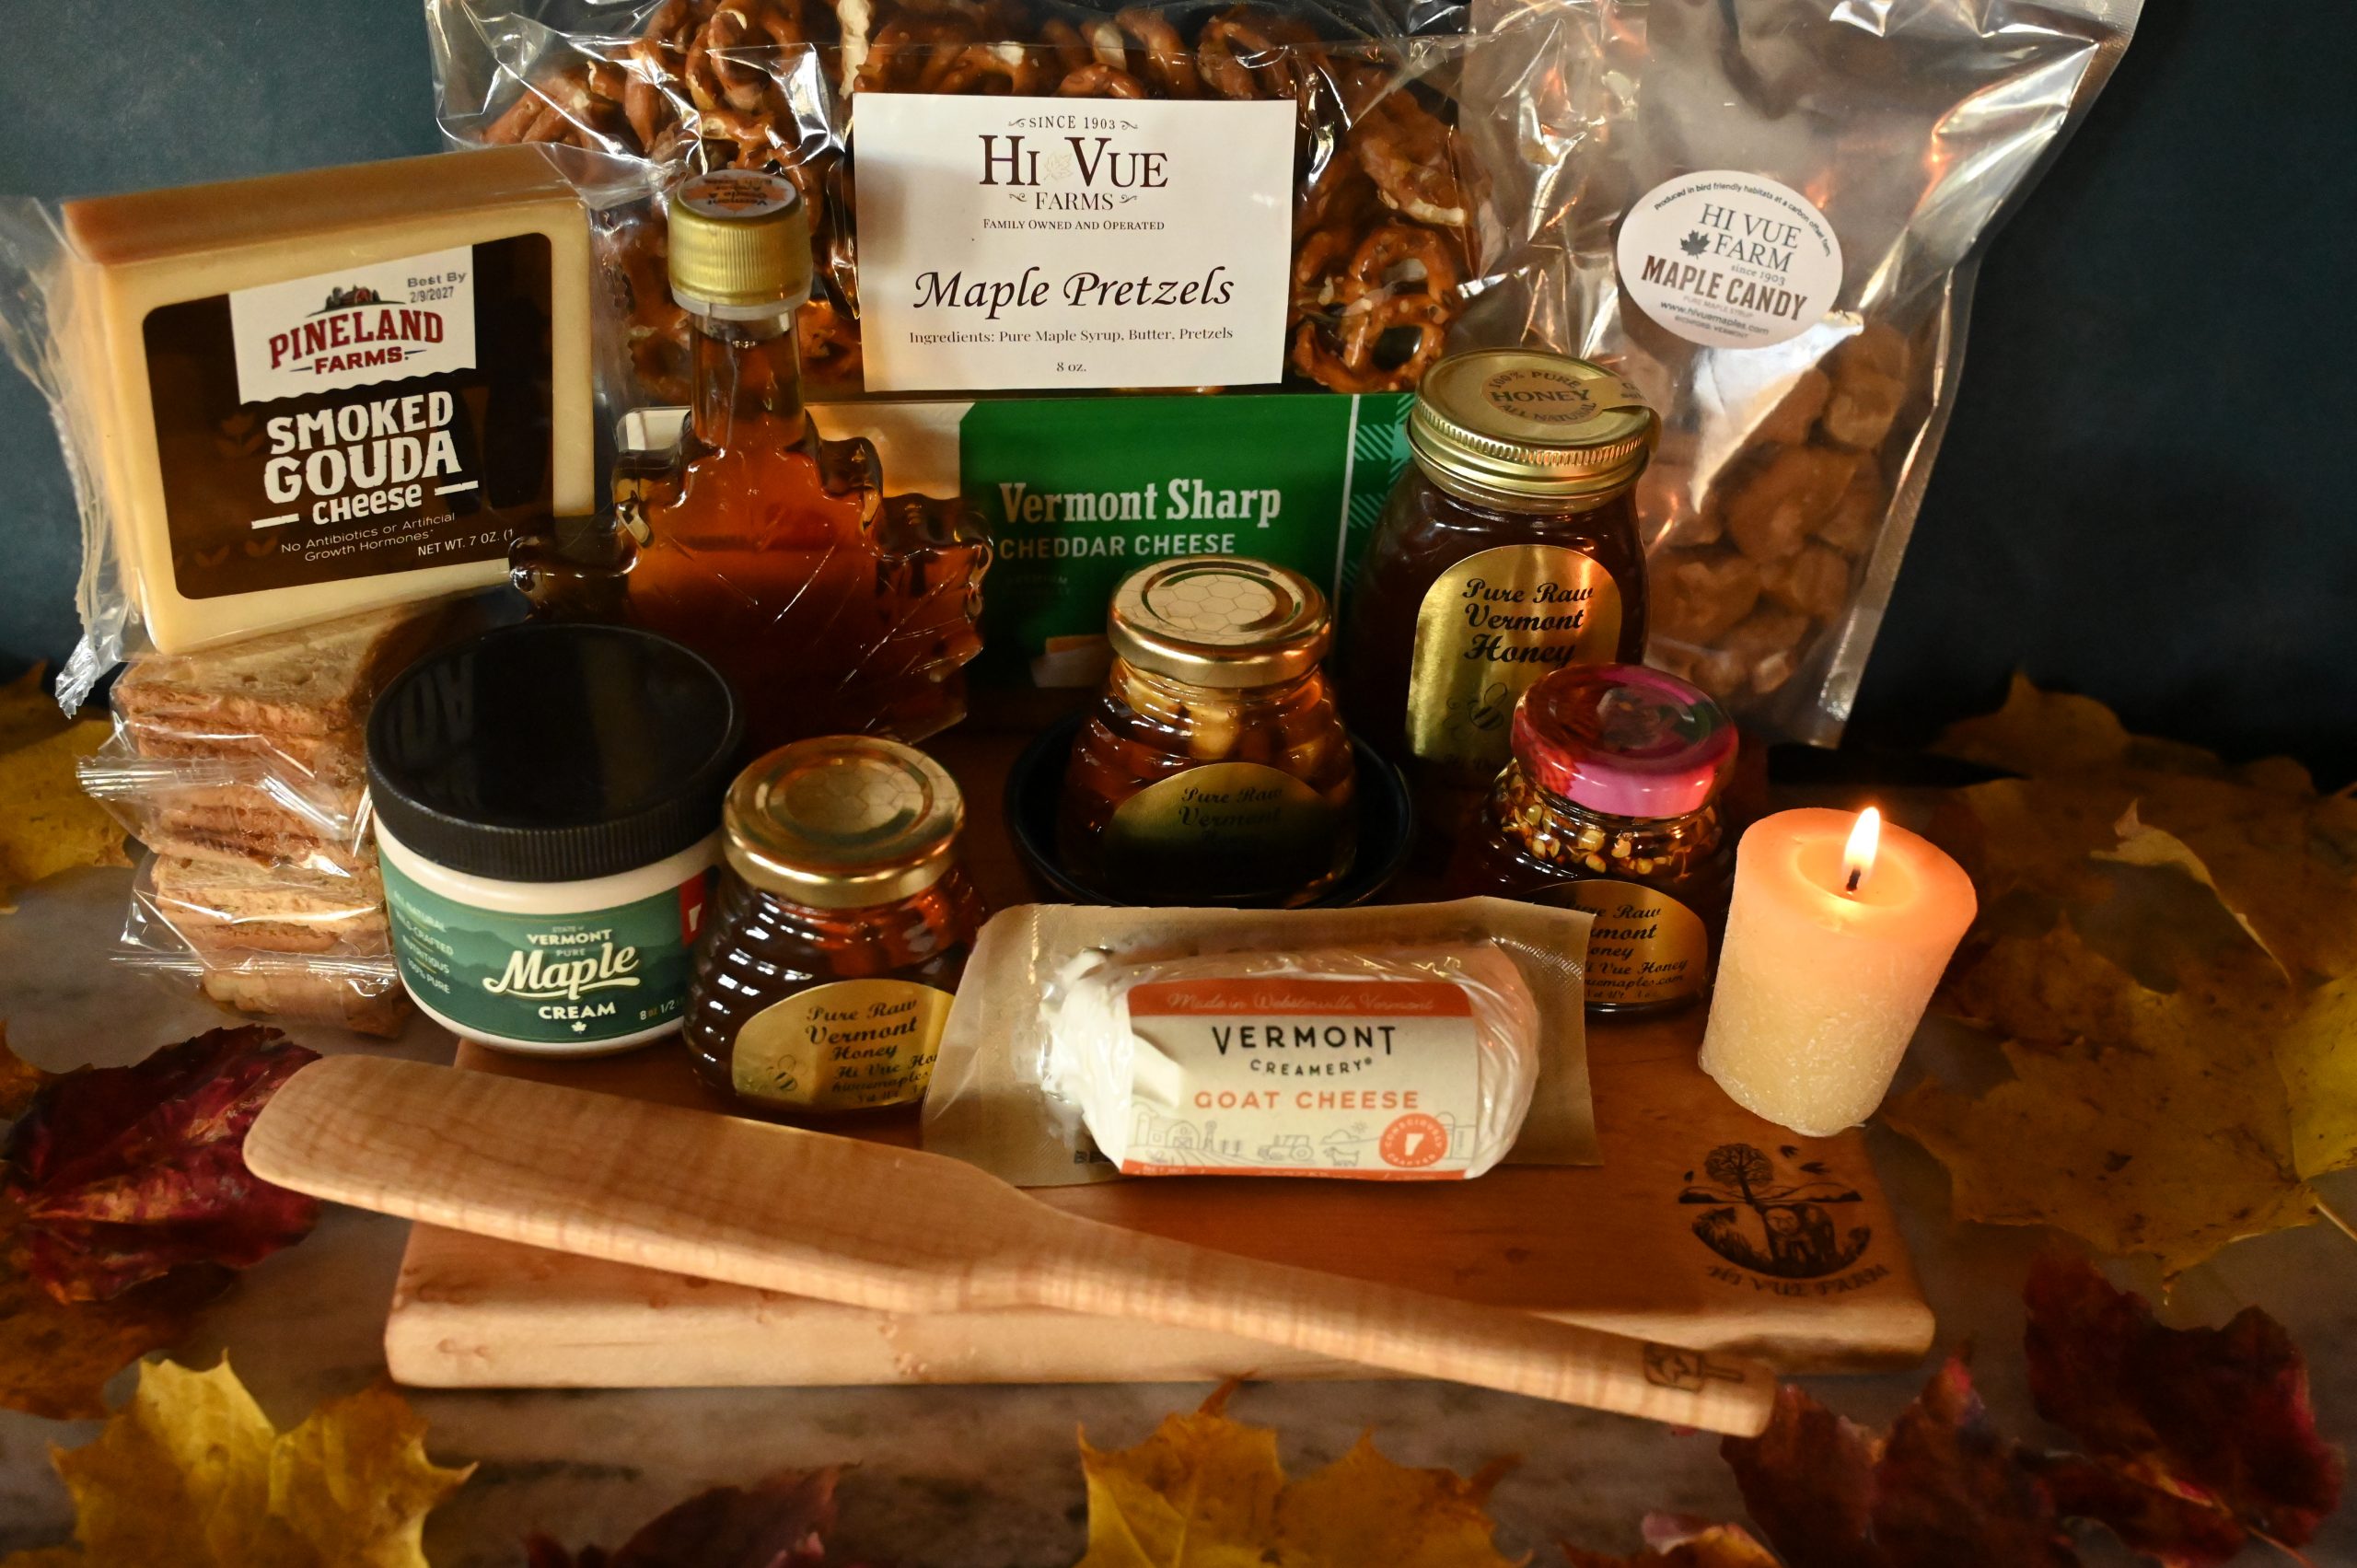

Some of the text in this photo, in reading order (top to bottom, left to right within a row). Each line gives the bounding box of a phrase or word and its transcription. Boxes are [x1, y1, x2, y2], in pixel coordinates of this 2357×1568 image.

[1029, 116, 1117, 131] SINCE 1903
[1036, 192, 1114, 211] FARMS
[1654, 188, 1687, 211] Produced
[1696, 183, 1712, 192] bird
[1713, 182, 1742, 192] friendly
[1744, 185, 1773, 199] habitats
[1774, 195, 1782, 203] at
[1788, 203, 1810, 223] carbon
[1698, 203, 1802, 249] HI VUE
[1713, 233, 1794, 273] FARM
[408, 272, 467, 288] Best By
[1731, 264, 1786, 286] since 1903
[411, 286, 455, 303] 2/9/2027
[913, 266, 1235, 319] Maple Pretzels
[1641, 254, 1808, 321] MAPLE CANDY
[268, 308, 444, 369] PINELAND
[910, 327, 1234, 344] Ingredients: Pure Maple Syrup, Butter, Pretzels
[1056, 362, 1087, 372] 8 oz.
[1489, 371, 1582, 389] 100% PURE
[1490, 389, 1591, 403] HONEY
[1500, 401, 1597, 423] ALL NATURAL
[266, 391, 454, 456] SMOKED
[263, 430, 462, 505] GOUDA
[999, 478, 1282, 528] Vermont Sharp
[282, 513, 456, 553] No Antibiotics or Artificial
[418, 544, 441, 556] NET
[445, 538, 466, 552] WT.
[470, 536, 477, 546] 7
[481, 531, 500, 544] OZ.
[305, 544, 355, 562] Growth
[999, 533, 1236, 560] CHEDDAR CHEESE
[1462, 577, 1594, 604] Pure Raw
[1464, 603, 1585, 632] Vermont
[1463, 633, 1576, 668] Honey
[1180, 787, 1230, 804] Pure
[1612, 904, 1662, 919] Raw
[527, 928, 613, 946] VERMONT
[1589, 923, 1658, 940] mont
[555, 947, 586, 958] PURE
[1589, 946, 1634, 961] oney
[482, 942, 641, 1001] Maple
[1637, 959, 1688, 975] Honey
[426, 973, 451, 994] PURE
[538, 1002, 617, 1020] CREAM
[806, 999, 918, 1023] Pure Raw
[1167, 992, 1225, 1010] Made
[1228, 1000, 1247, 1010] in
[1359, 993, 1434, 1010] Vermont
[639, 1010, 647, 1021] 8
[805, 1016, 918, 1046] Vermont
[1212, 1026, 1396, 1055] VERMONT
[830, 1043, 899, 1063] Honey
[1194, 1090, 1420, 1110] GOAT CHEESE
